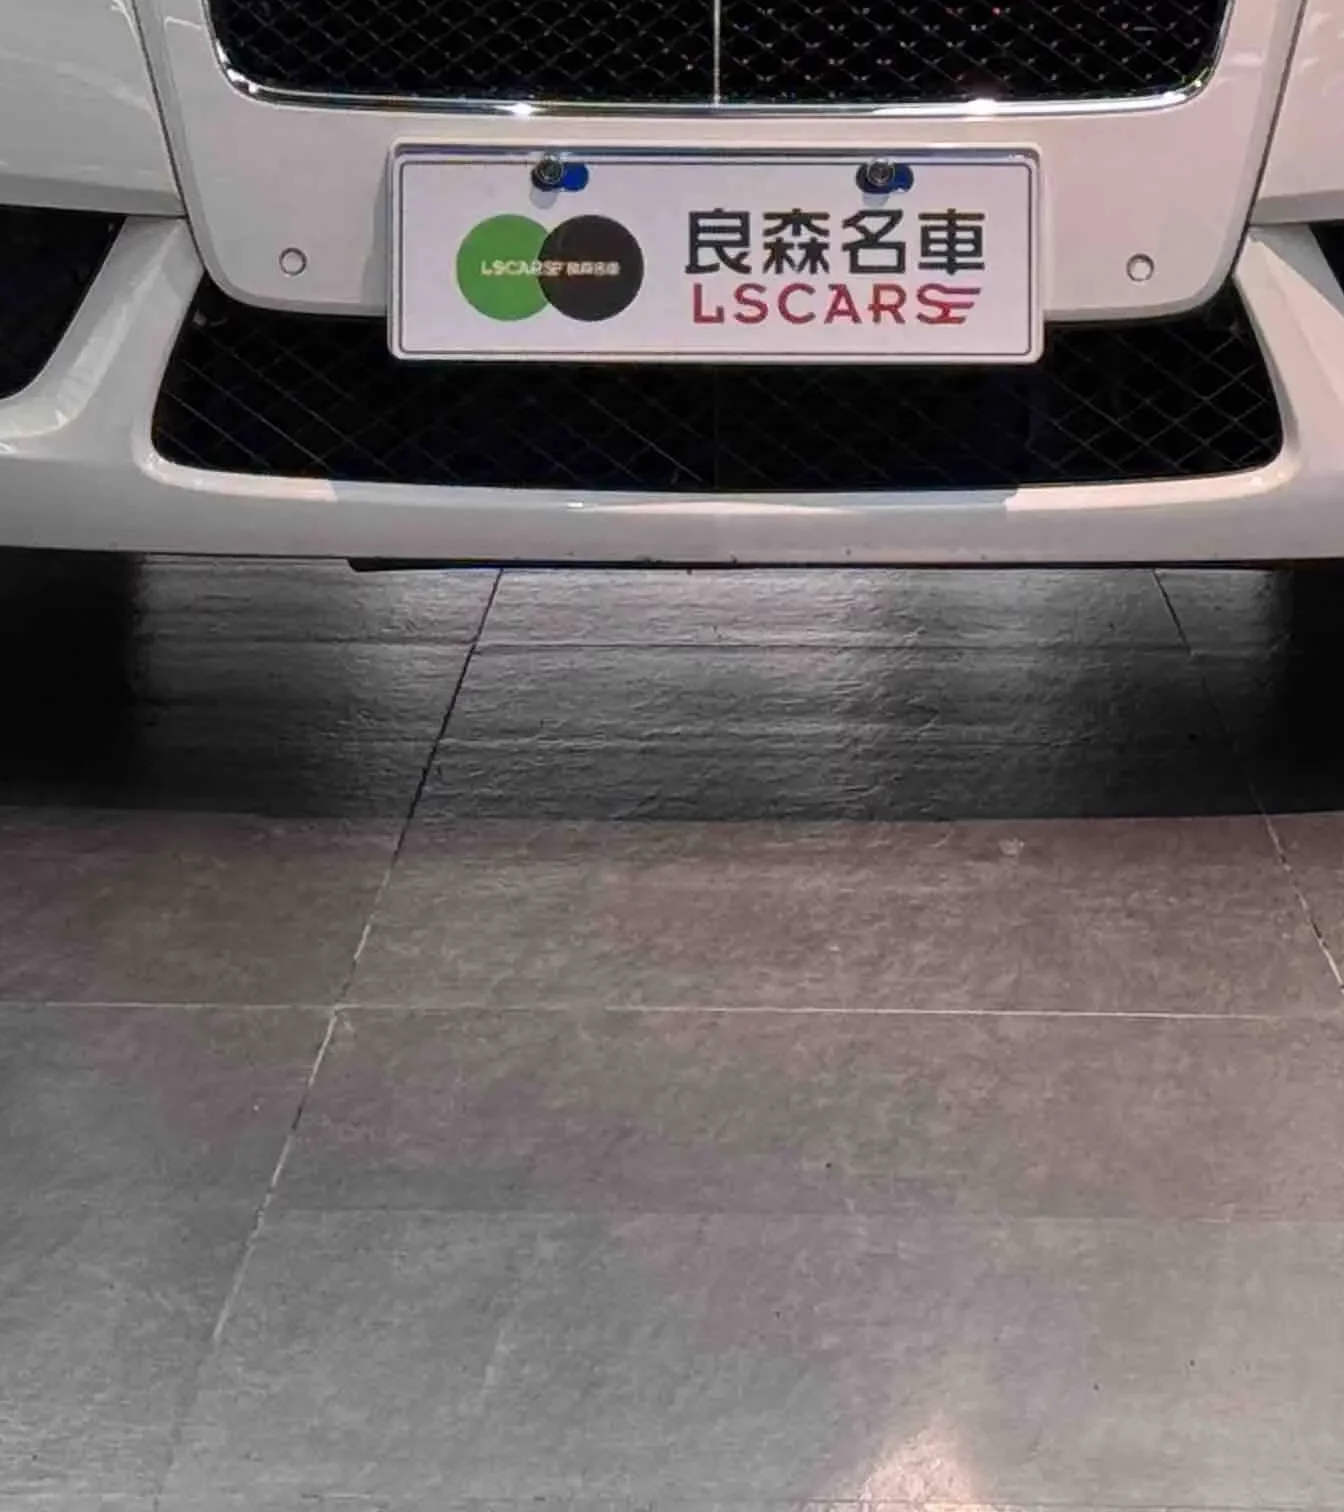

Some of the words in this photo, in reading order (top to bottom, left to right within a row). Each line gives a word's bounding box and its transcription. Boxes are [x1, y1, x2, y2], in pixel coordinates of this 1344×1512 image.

[685, 208, 985, 275] 良森名車
[693, 283, 982, 325] LSCARS
